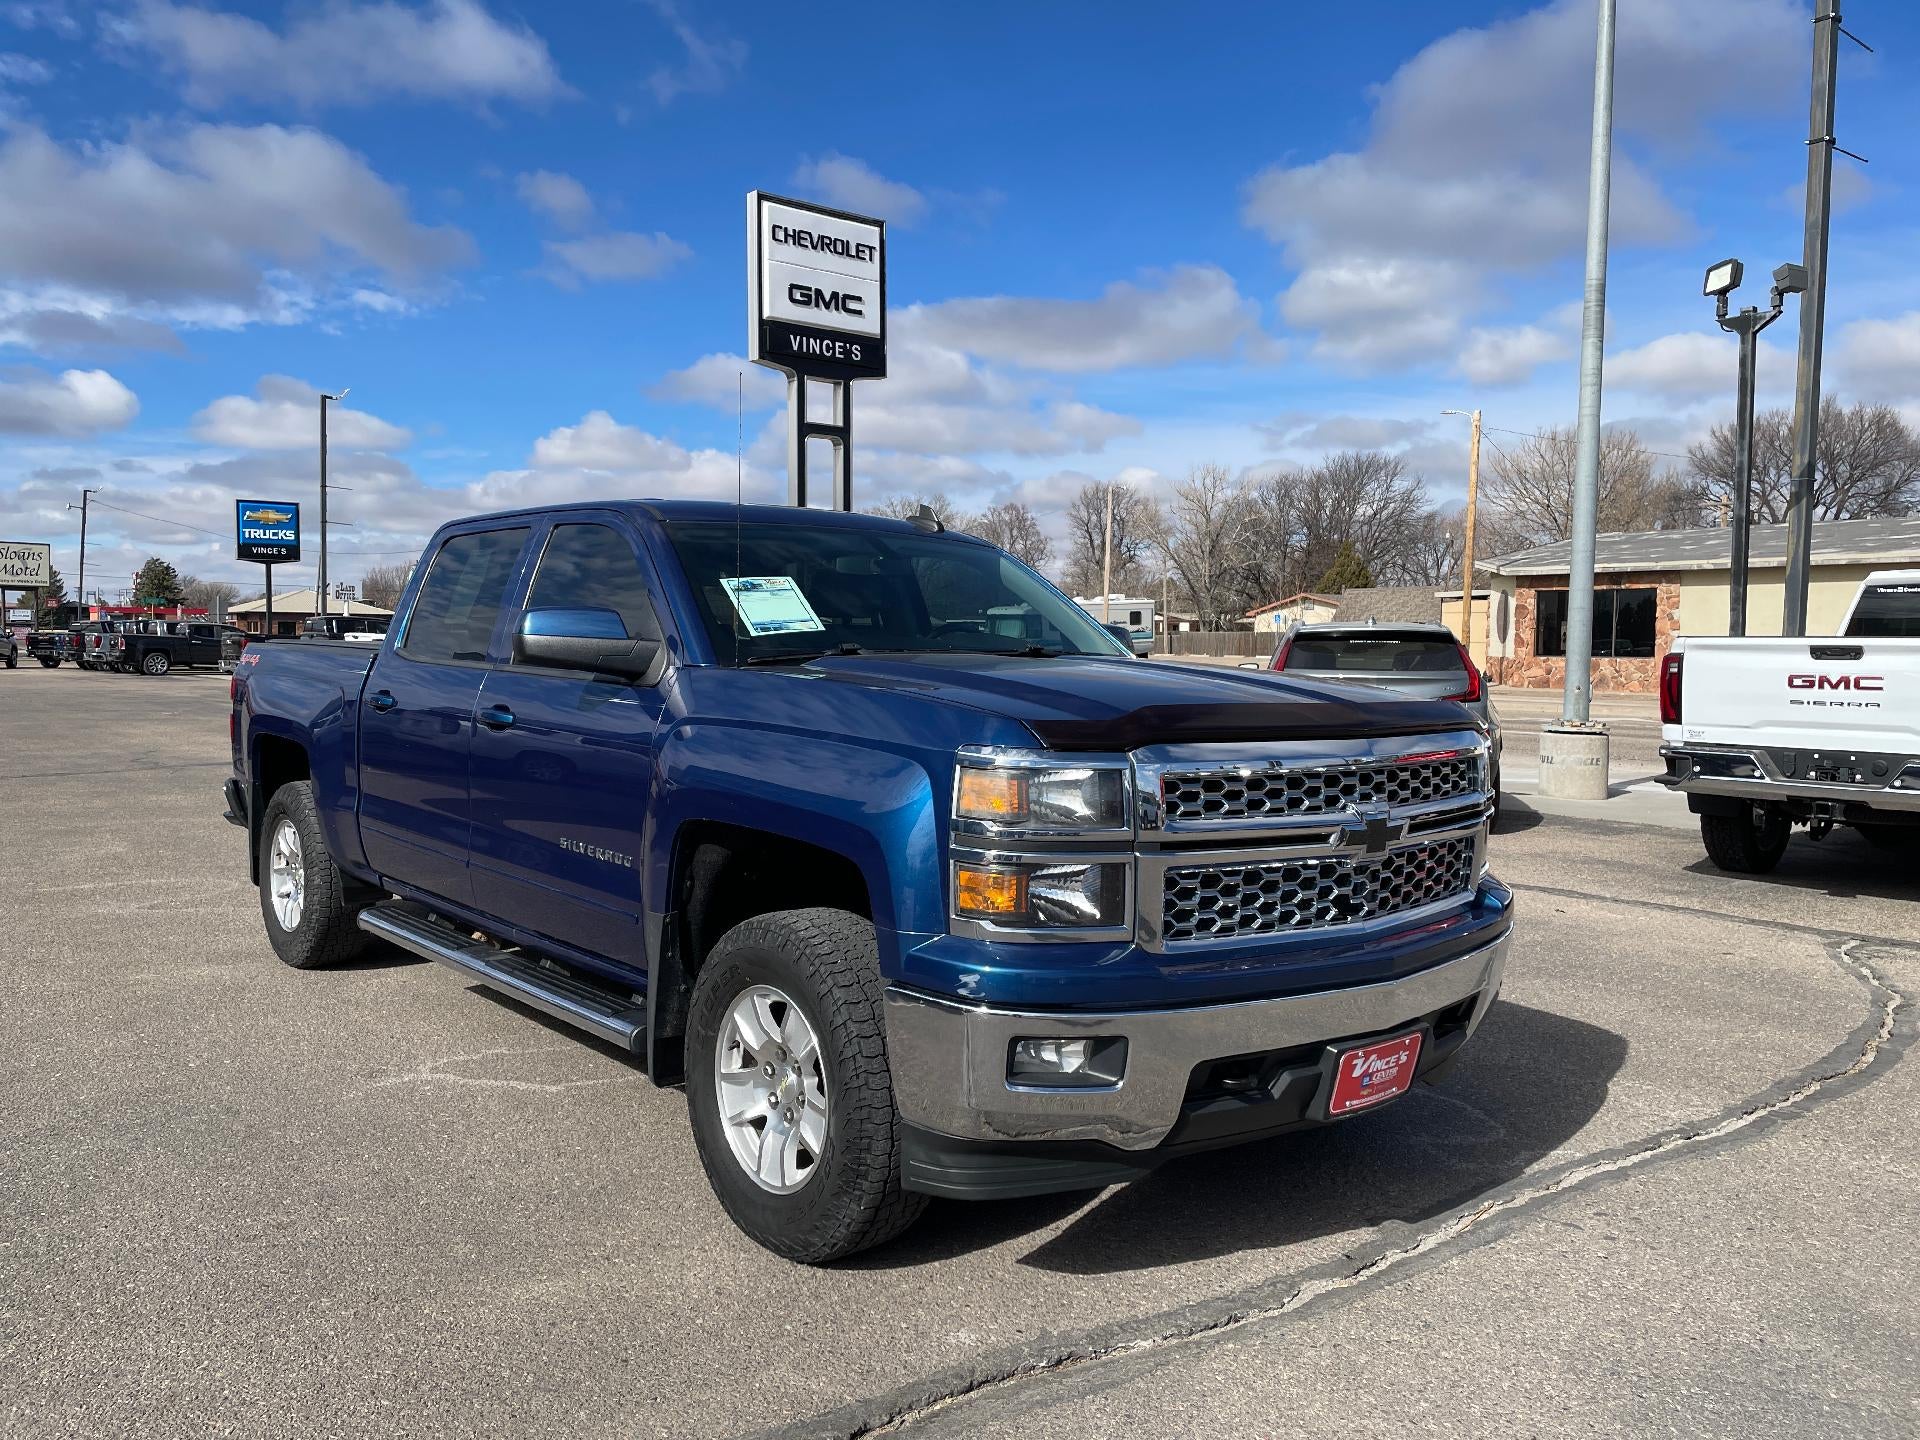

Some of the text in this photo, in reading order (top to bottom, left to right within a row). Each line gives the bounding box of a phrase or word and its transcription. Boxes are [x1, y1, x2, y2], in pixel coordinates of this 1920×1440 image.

[771, 224, 877, 263] CHEVROLET
[788, 283, 863, 316] GMC
[790, 334, 862, 361] VINCE'S
[242, 528, 295, 540] TRUCKS
[252, 546, 287, 555] VINCE'S
[0, 563, 40, 577] Motel
[1787, 674, 1885, 691] GMC
[1789, 699, 1881, 708] SIERRA
[559, 837, 633, 868] SILVERADO
[1351, 1050, 1410, 1078] VINCE'S
